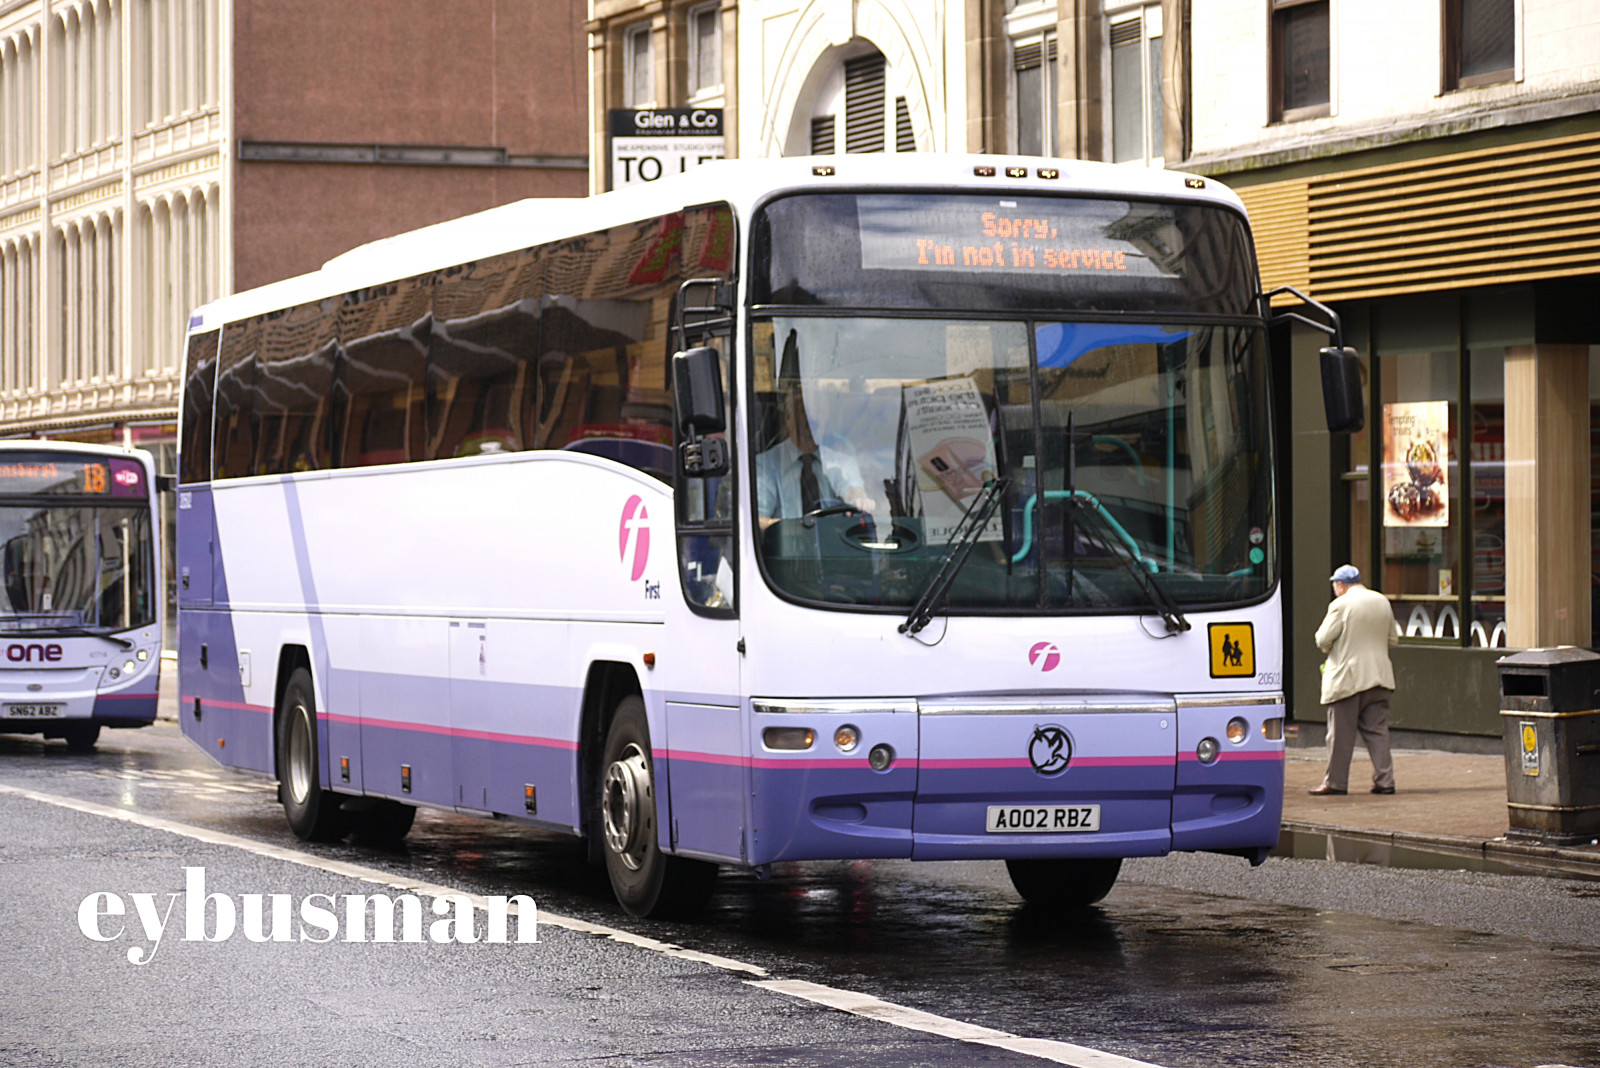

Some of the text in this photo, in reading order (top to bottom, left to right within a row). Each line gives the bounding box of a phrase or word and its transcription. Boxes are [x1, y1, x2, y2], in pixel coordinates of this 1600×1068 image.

[634, 109, 719, 128] Glen & Co
[618, 156, 662, 182] TO
[981, 211, 1058, 239] Sorry,
[916, 238, 1128, 270] I'm not in service
[644, 579, 661, 599] First
[7, 643, 63, 662] one
[9, 706, 36, 716] SN62
[1054, 808, 1092, 828] RBZ
